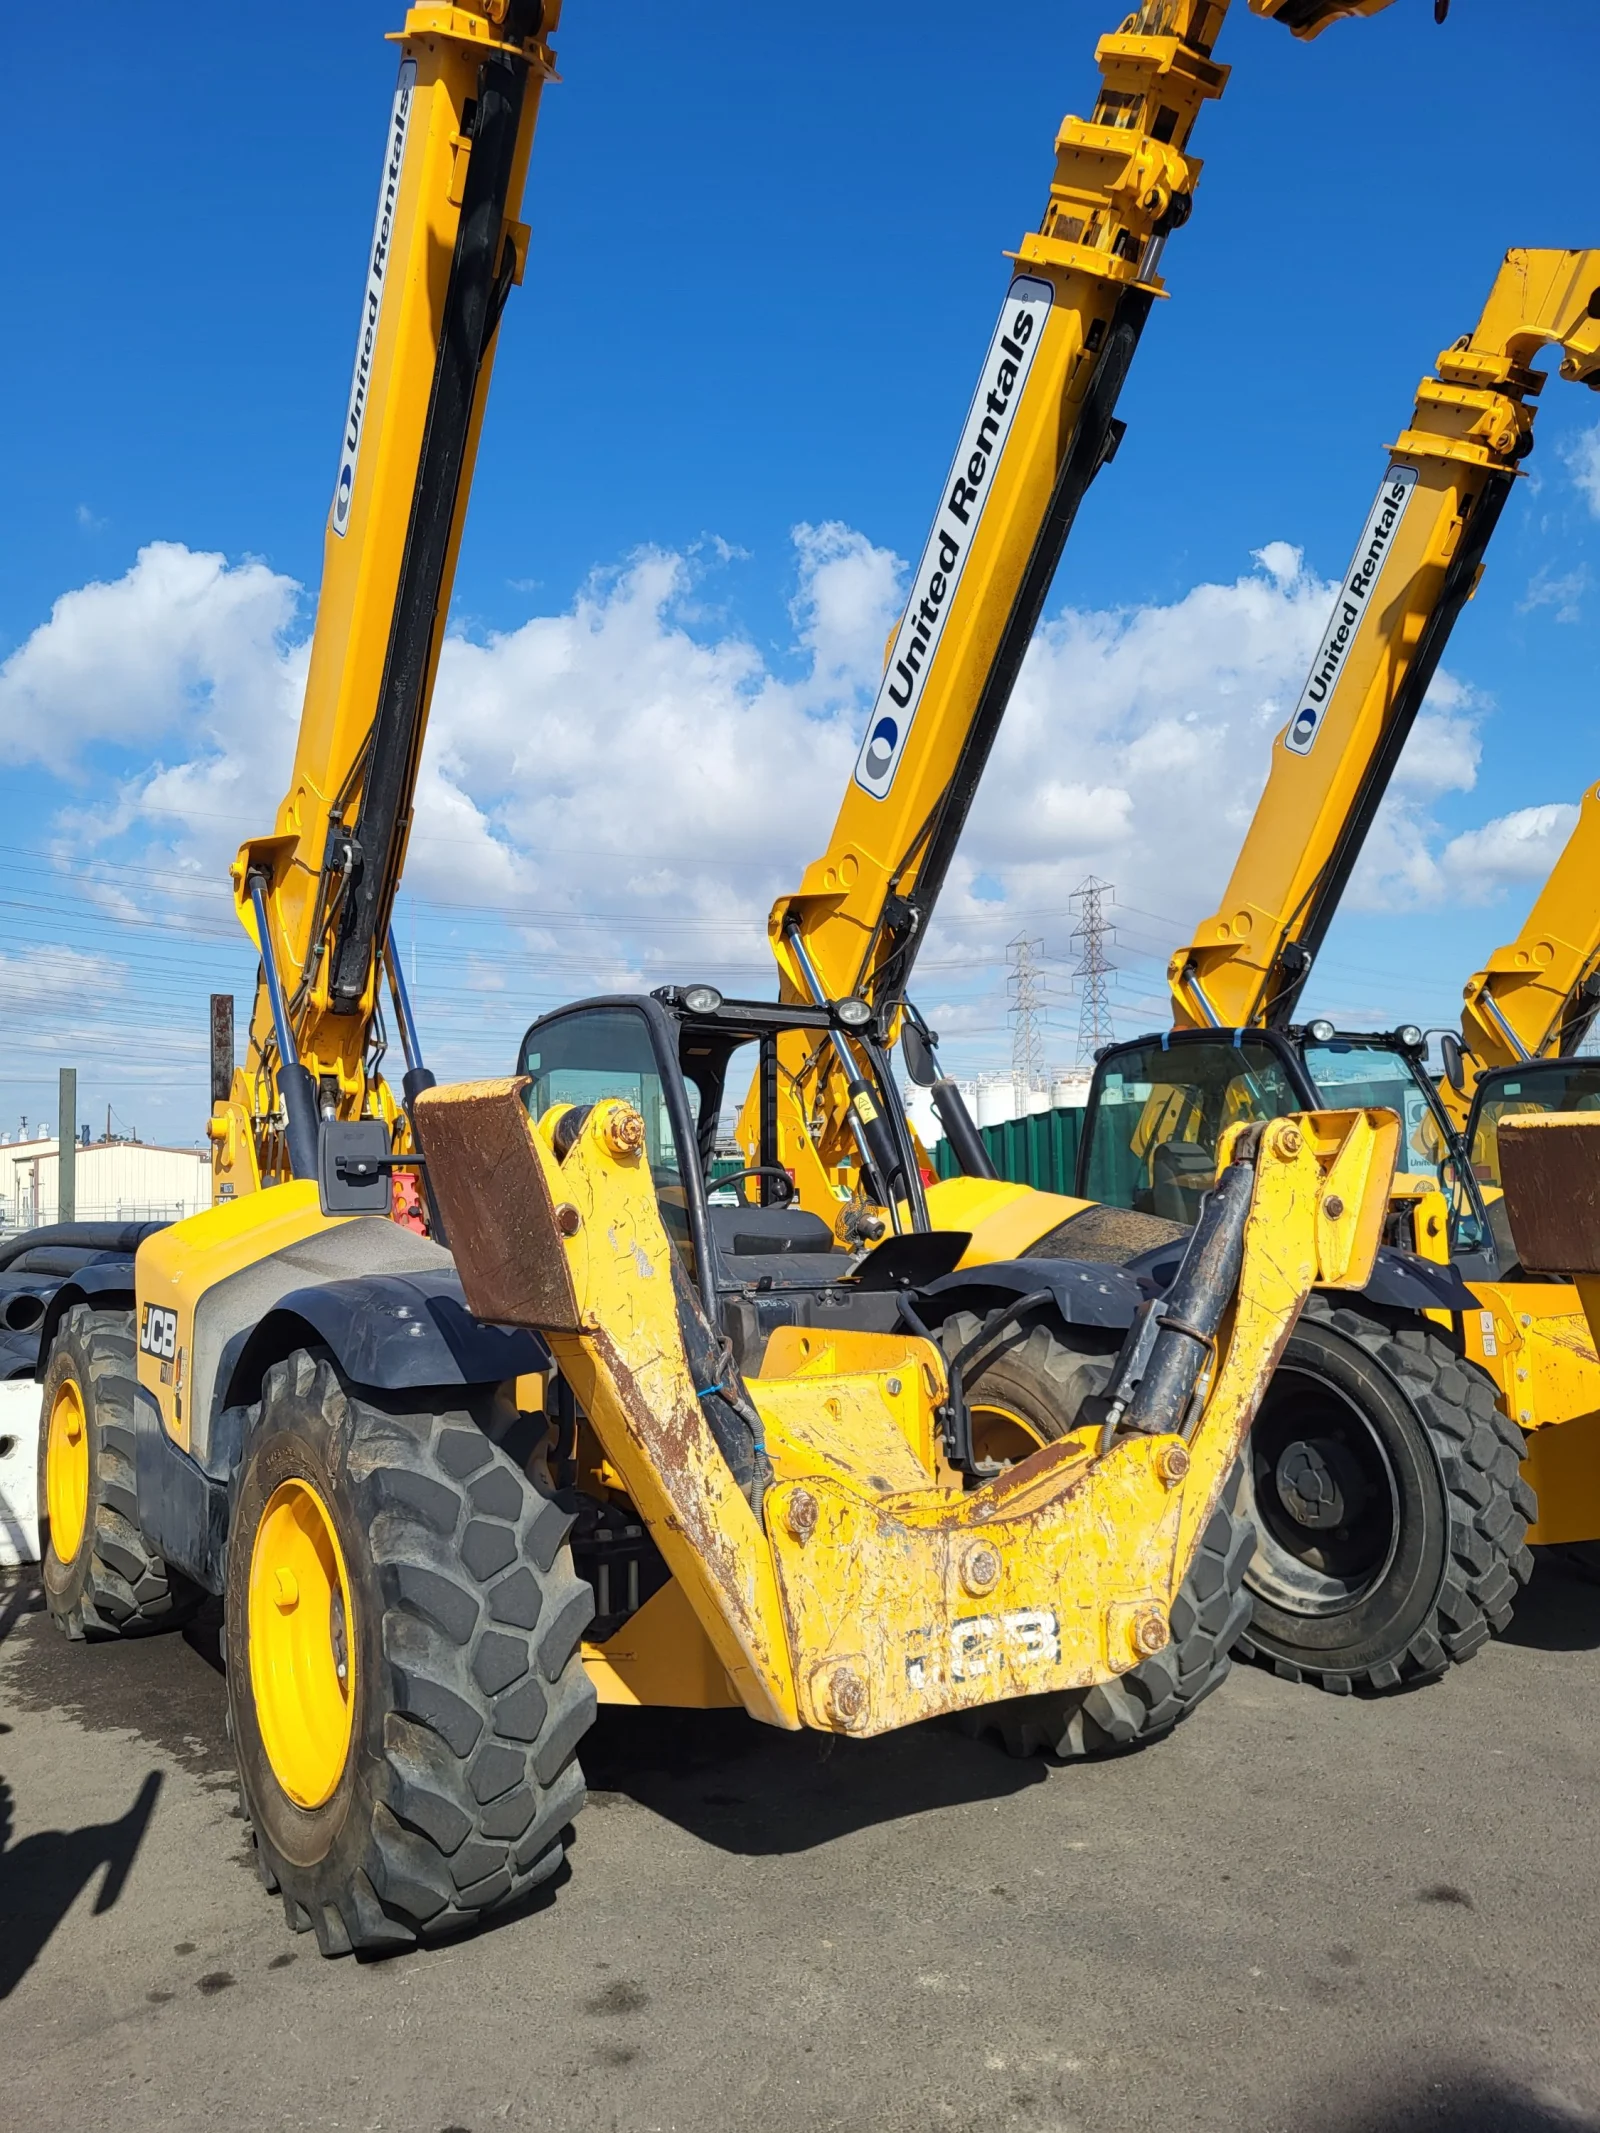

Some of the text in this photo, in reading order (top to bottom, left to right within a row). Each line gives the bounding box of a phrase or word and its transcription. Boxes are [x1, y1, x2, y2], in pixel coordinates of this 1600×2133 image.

[347, 88, 409, 453] United Rentals
[888, 309, 1034, 708] United Rentals
[1308, 482, 1406, 703] United Rentals
[141, 1307, 176, 1358] JCB
